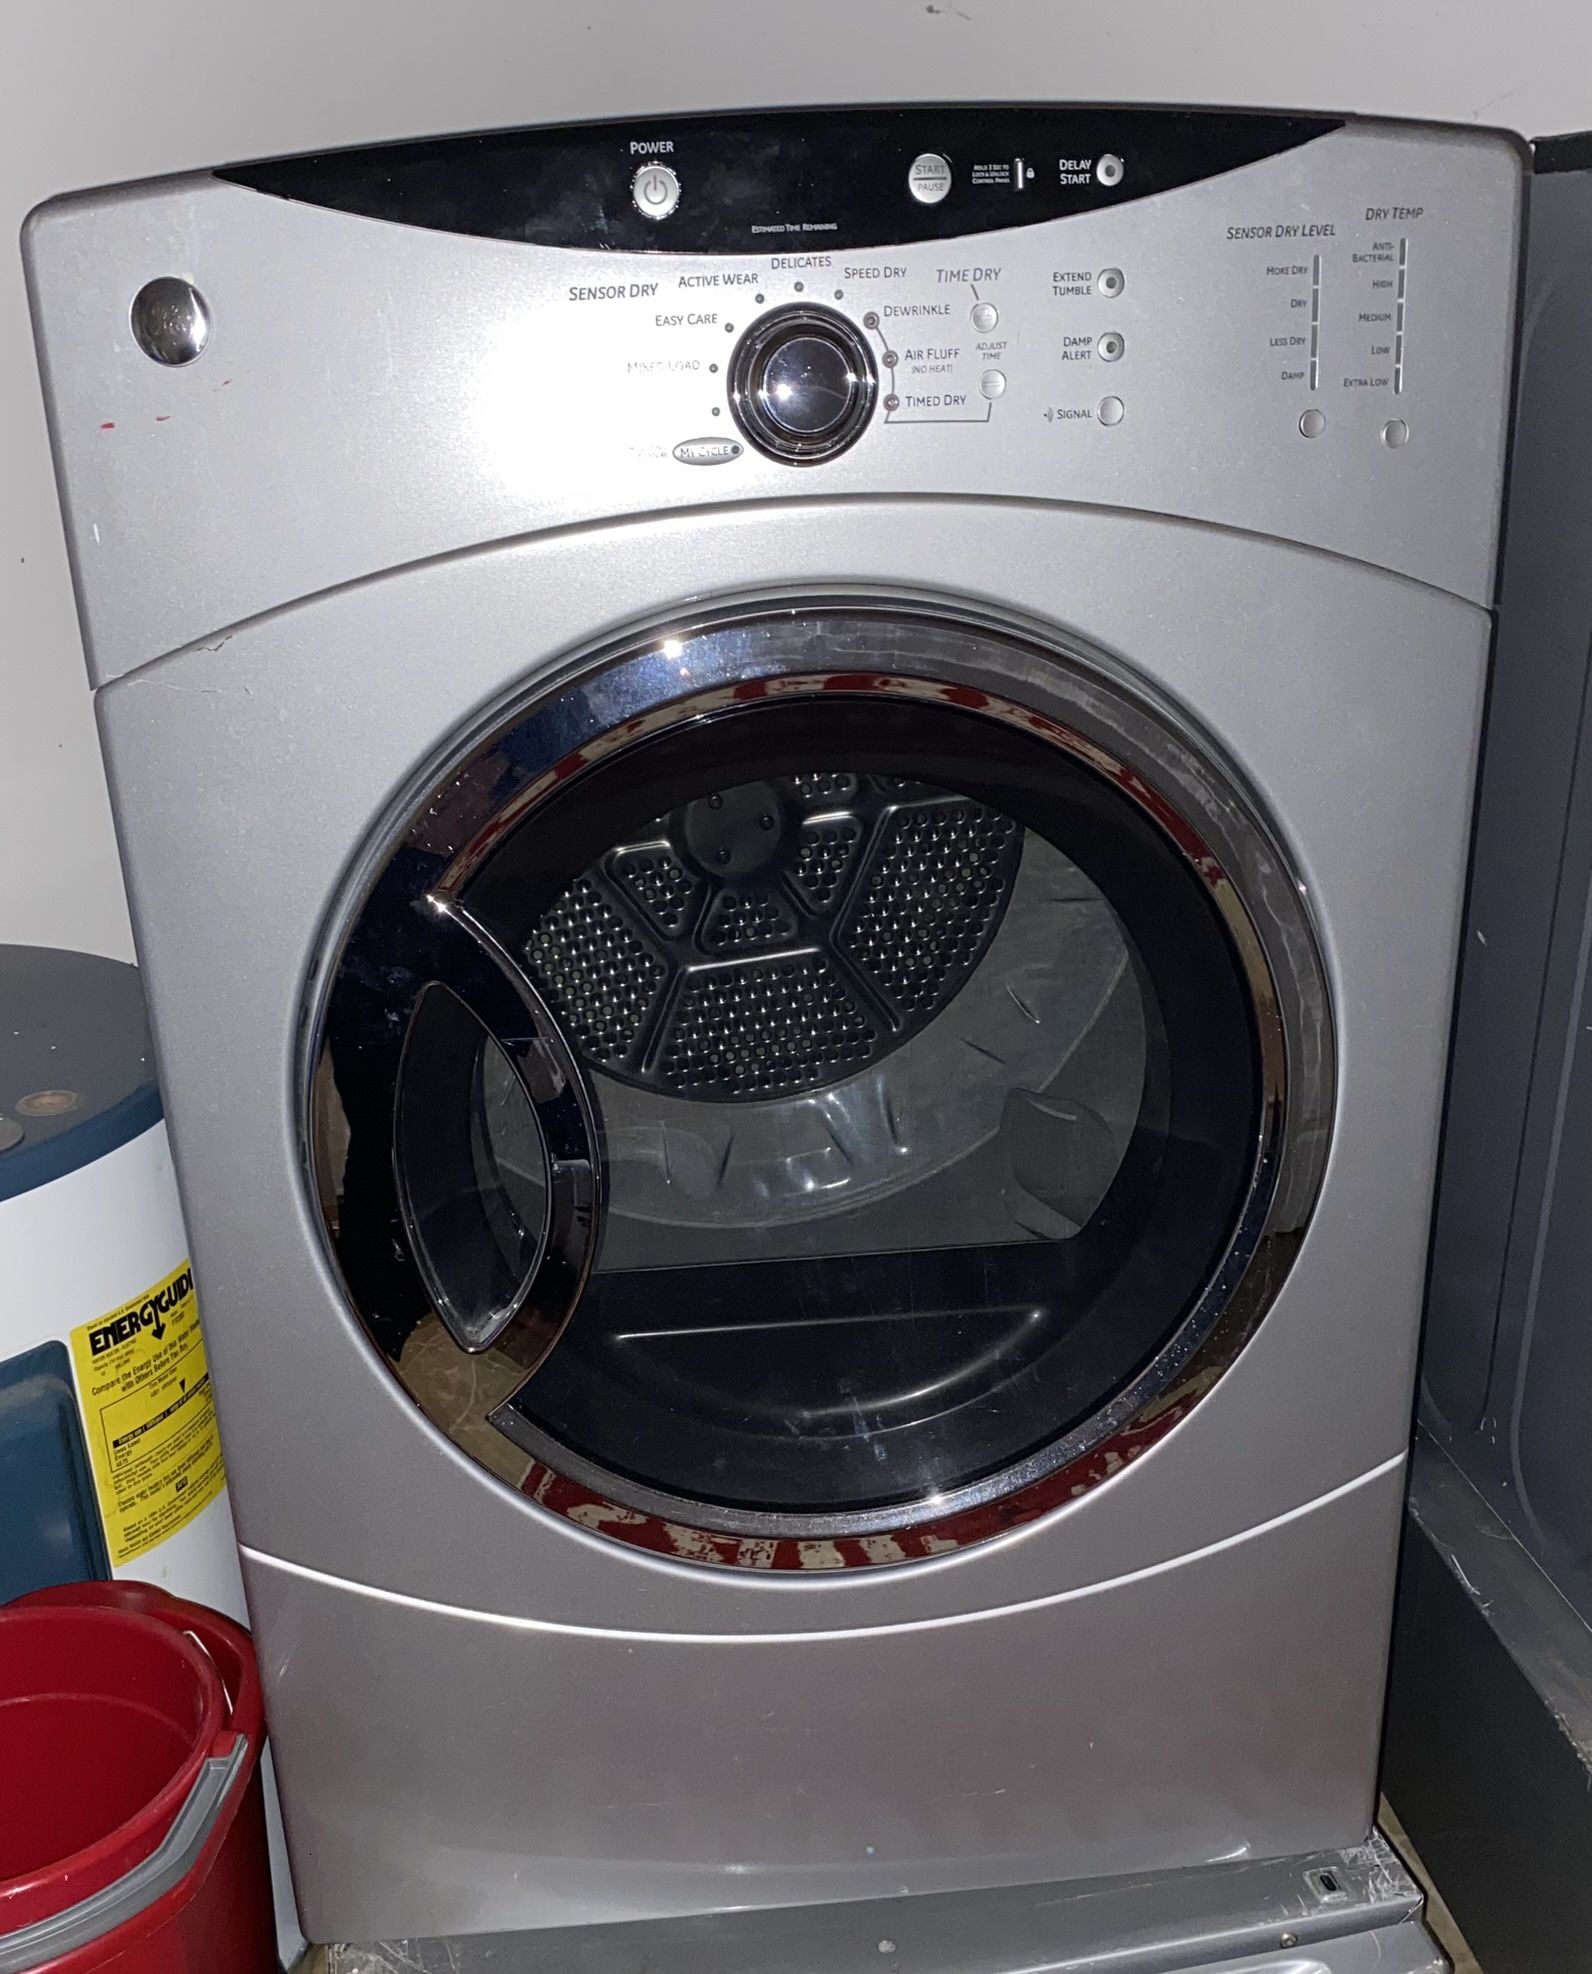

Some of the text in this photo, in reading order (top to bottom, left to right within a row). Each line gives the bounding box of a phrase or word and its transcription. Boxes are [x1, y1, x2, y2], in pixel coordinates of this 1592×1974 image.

[630, 141, 674, 154] POWER
[916, 164, 945, 176] START
[1059, 159, 1092, 171] DELAY
[1060, 174, 1091, 184] START
[918, 182, 944, 192] PAUSE
[1366, 207, 1424, 220] DRY TEMP
[752, 225, 785, 234] ESTIMATED
[802, 223, 838, 231] REMAINING
[1226, 224, 1336, 240] SENSOR DRY LEVEL
[771, 256, 832, 270] DELICATES
[1352, 254, 1394, 263] BACTERIAL
[844, 266, 907, 280] SPEED DRY
[936, 267, 1002, 283] TIME DRY
[1266, 265, 1308, 276] MORE DRY
[678, 273, 758, 288] ACTIVE WEAR
[1053, 272, 1092, 282] EXTEND
[1372, 280, 1393, 288] HIGH
[569, 283, 658, 301] SENSOR DRY
[1052, 286, 1092, 296] TUMBLE
[1291, 299, 1307, 308] DRY
[884, 304, 950, 317] DEWRINKLE
[655, 314, 718, 326] EASY CARE
[1358, 313, 1392, 322] MEDIUM
[976, 341, 1008, 350] ADJUST
[1063, 336, 1092, 347] DAMP
[1270, 336, 1306, 346] LESS DRY
[904, 348, 960, 360] AIR FLUFF
[1062, 350, 1091, 360] ALERT
[1372, 346, 1390, 354] LOW
[982, 352, 1002, 360] TIME
[912, 363, 953, 374] (NO HEAT)
[1282, 371, 1304, 380] DAMP
[1344, 378, 1389, 388] EXTRA LOW
[906, 394, 966, 408] TIMED DRY
[1057, 409, 1092, 420] SIGNAL
[698, 446, 728, 457] CYCLE
[92, 1376, 120, 1396] Compare
[122, 1371, 132, 1382] the
[133, 1359, 152, 1375] Energy
